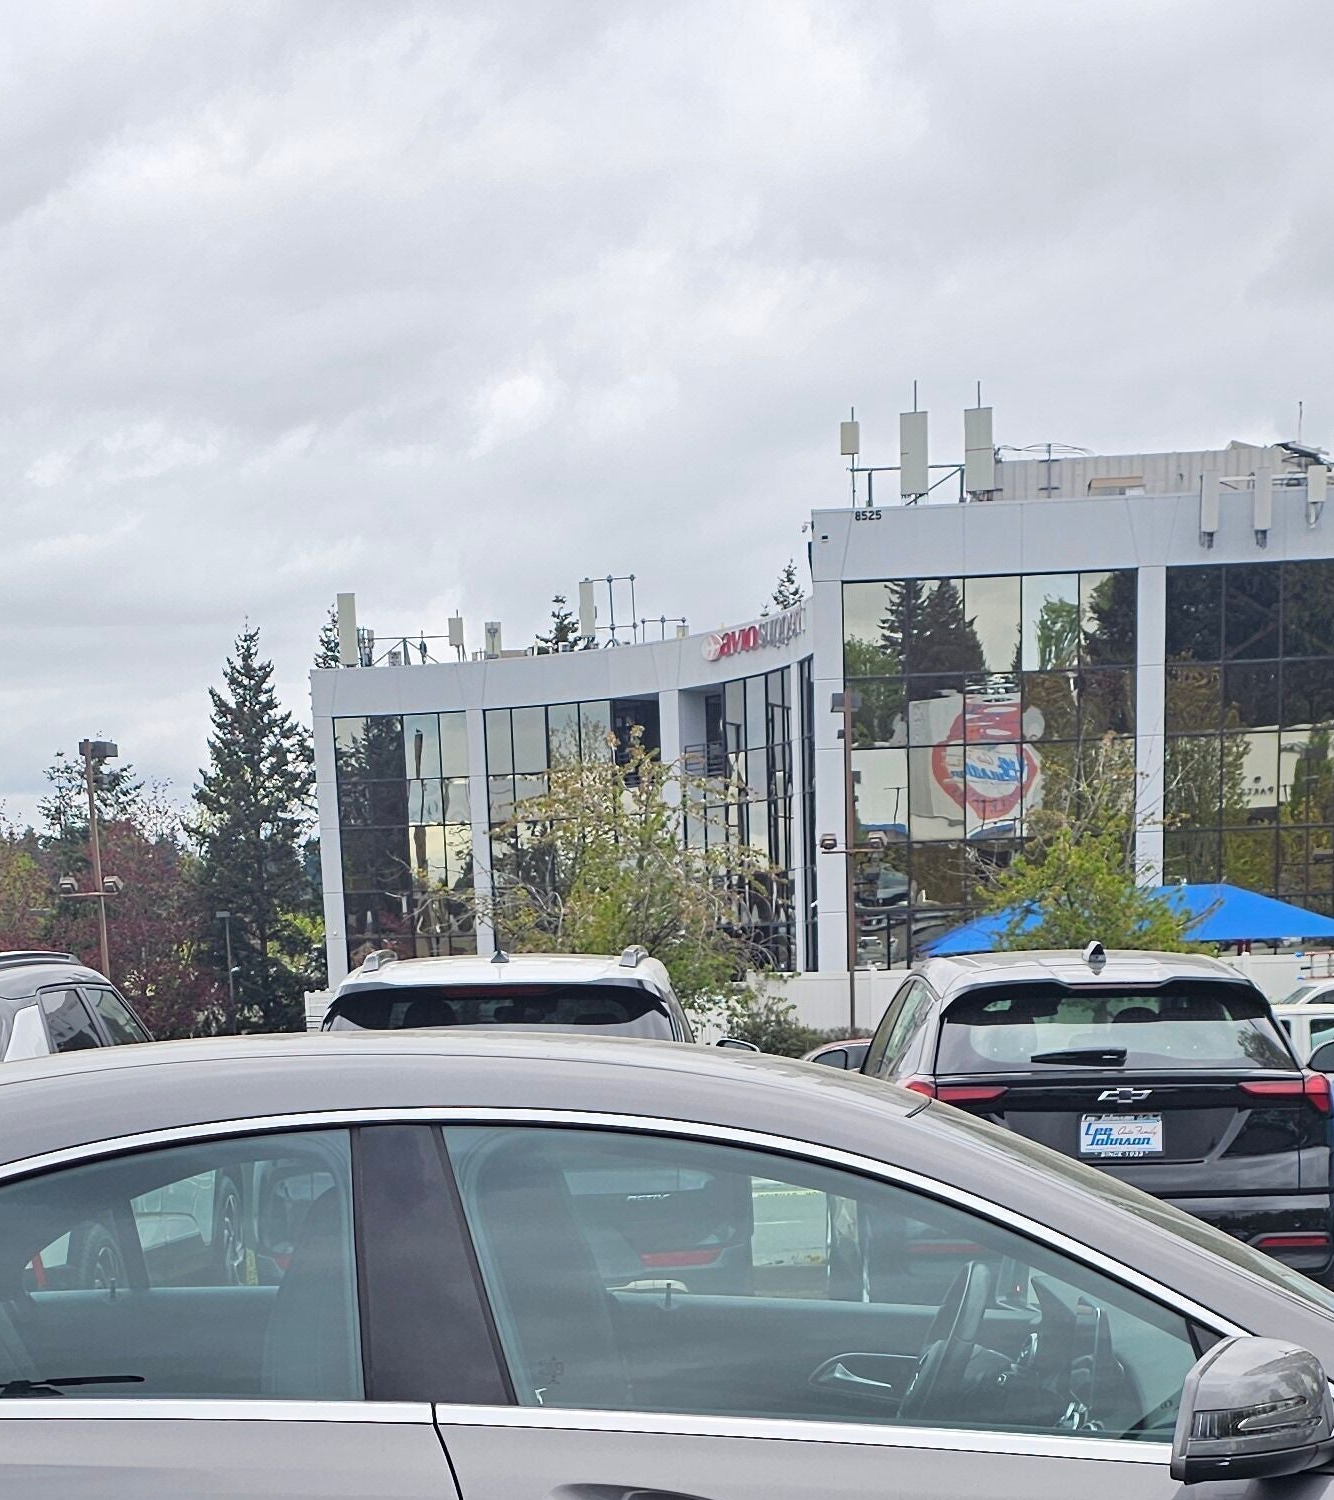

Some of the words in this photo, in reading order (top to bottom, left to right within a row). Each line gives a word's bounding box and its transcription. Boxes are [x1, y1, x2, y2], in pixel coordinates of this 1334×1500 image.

[855, 510, 882, 521] 8525
[1085, 1122, 1114, 1136] Lee
[1086, 1132, 1152, 1147] Johnson
